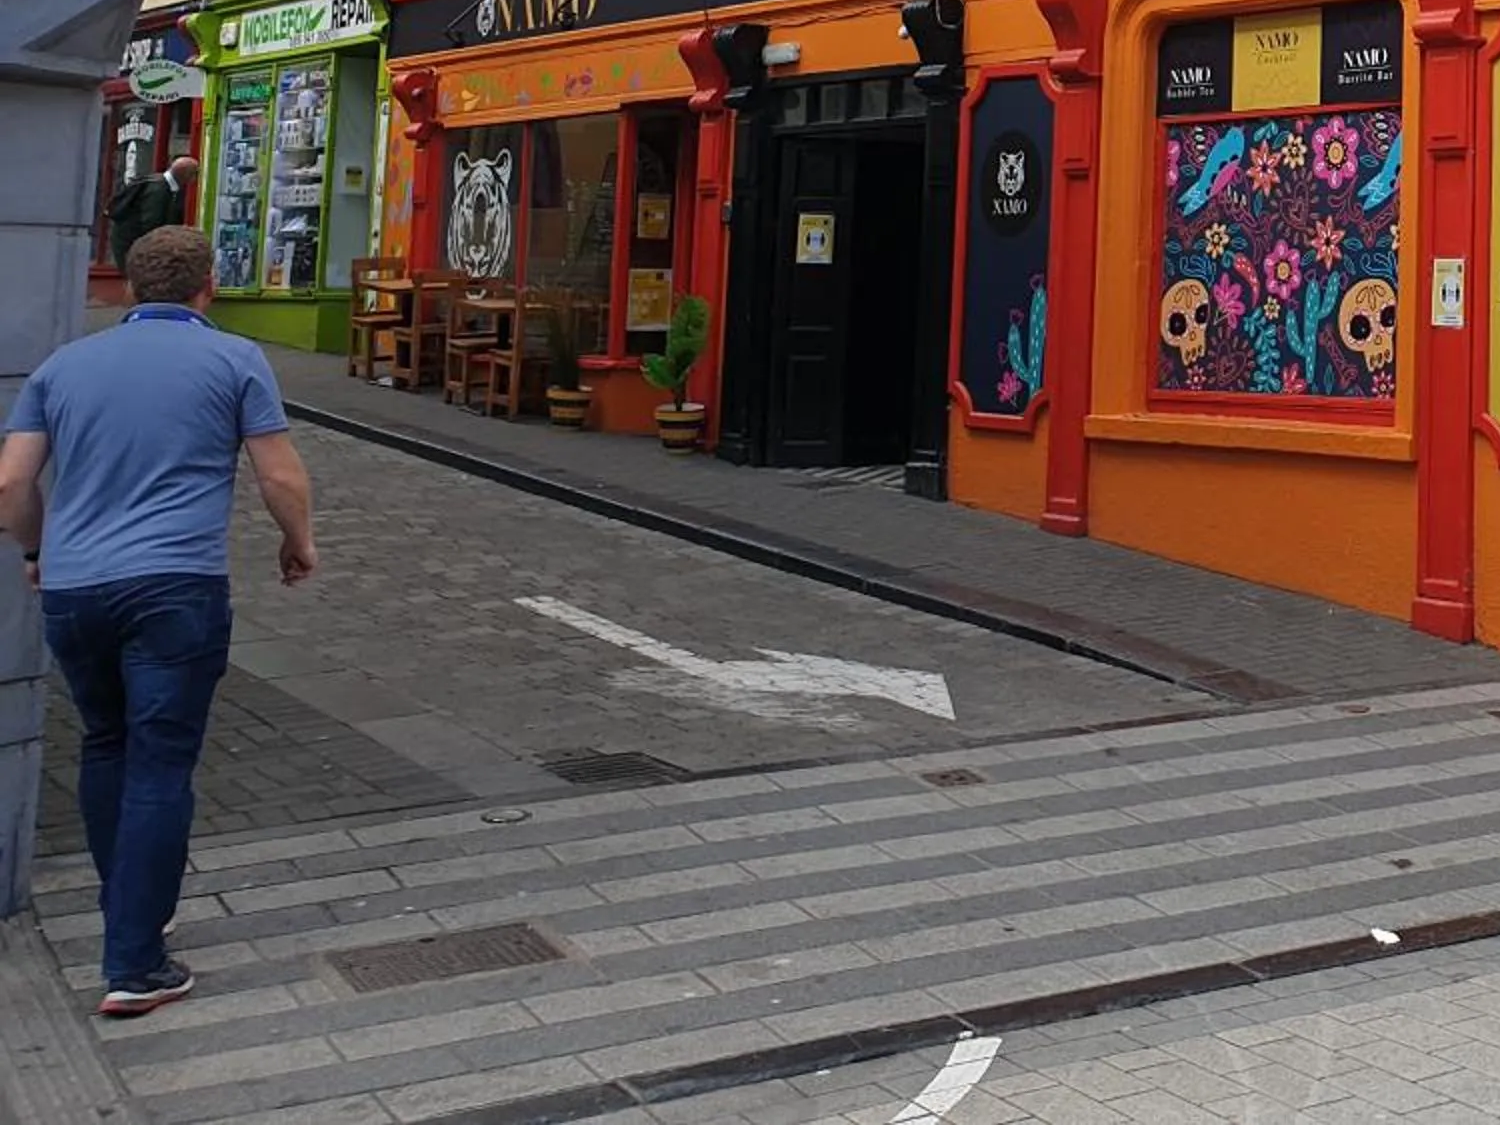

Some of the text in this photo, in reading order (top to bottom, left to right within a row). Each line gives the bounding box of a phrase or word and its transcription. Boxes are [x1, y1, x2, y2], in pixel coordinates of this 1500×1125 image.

[1255, 30, 1299, 51] NAMO
[1343, 48, 1388, 68] NAMO
[1171, 66, 1211, 84] NAMO
[1338, 71, 1393, 85] Burrito Bar
[1167, 87, 1195, 98] Bubble
[992, 198, 1027, 215] NAMO
